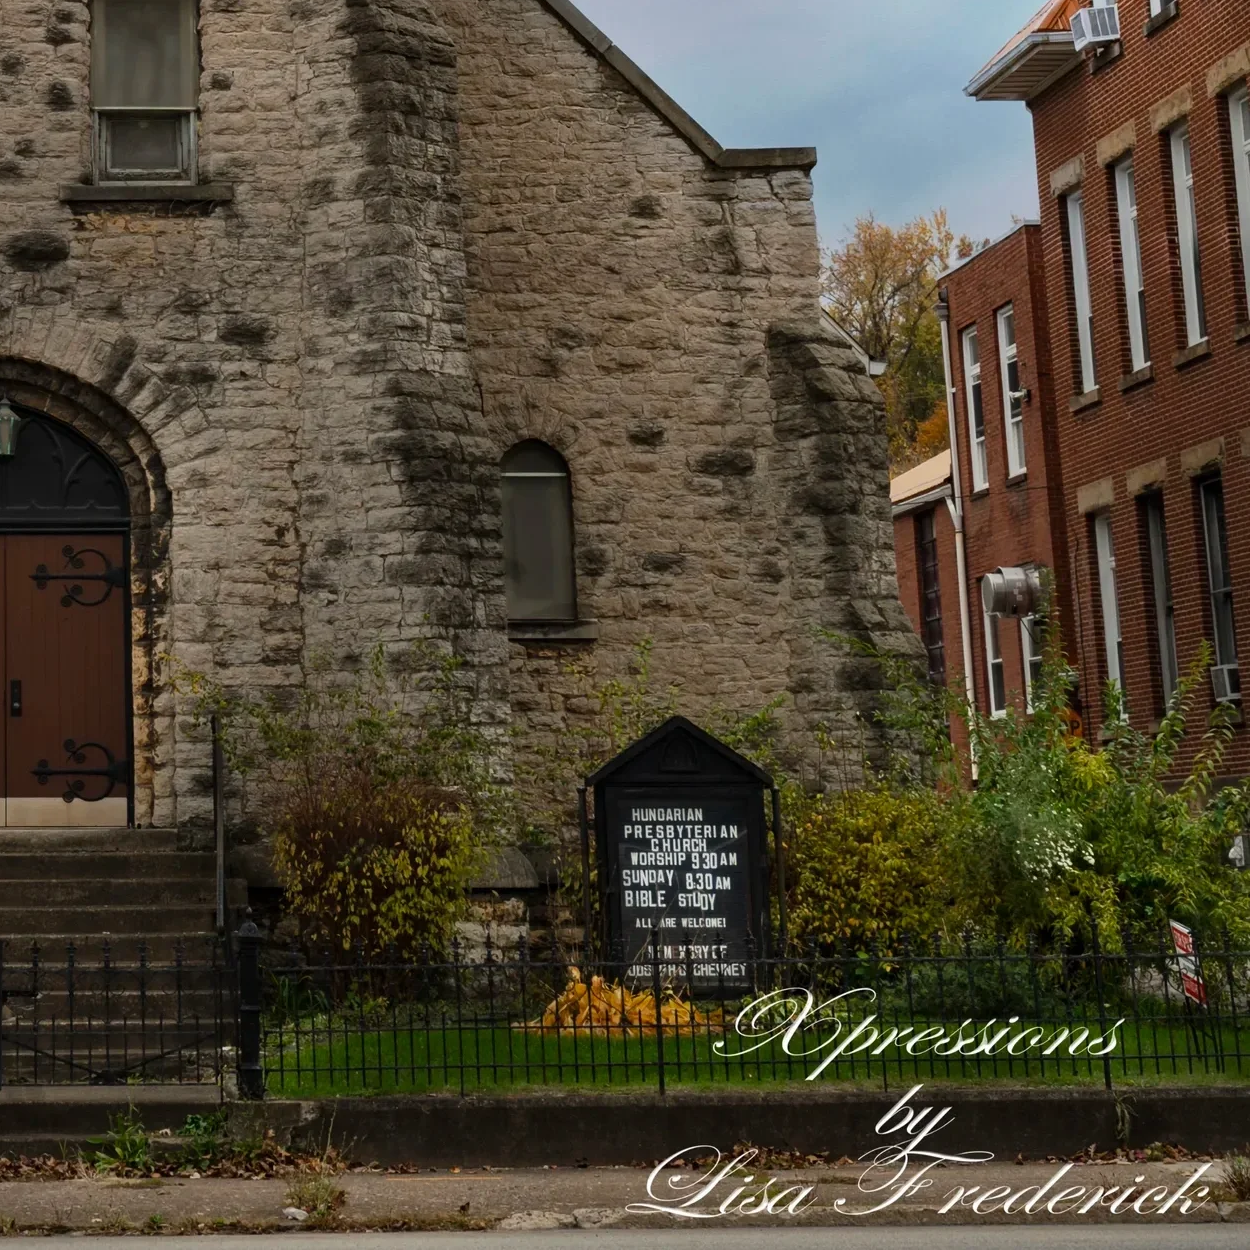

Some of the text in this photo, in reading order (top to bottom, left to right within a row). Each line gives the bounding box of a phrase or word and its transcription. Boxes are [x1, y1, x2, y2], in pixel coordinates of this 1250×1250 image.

[632, 808, 703, 822] HUNGARIAN
[624, 825, 738, 839] PRESBYTERIAN
[651, 839, 707, 852] CHURCH
[630, 852, 686, 866] WORSHIP
[720, 852, 738, 866] AM
[622, 869, 731, 890] SUNDAY 8:30 AM
[625, 890, 716, 911] BIBLE STUDY
[635, 917, 727, 928] ALL ARE WELCOME!
[629, 964, 676, 977] JOSPH
